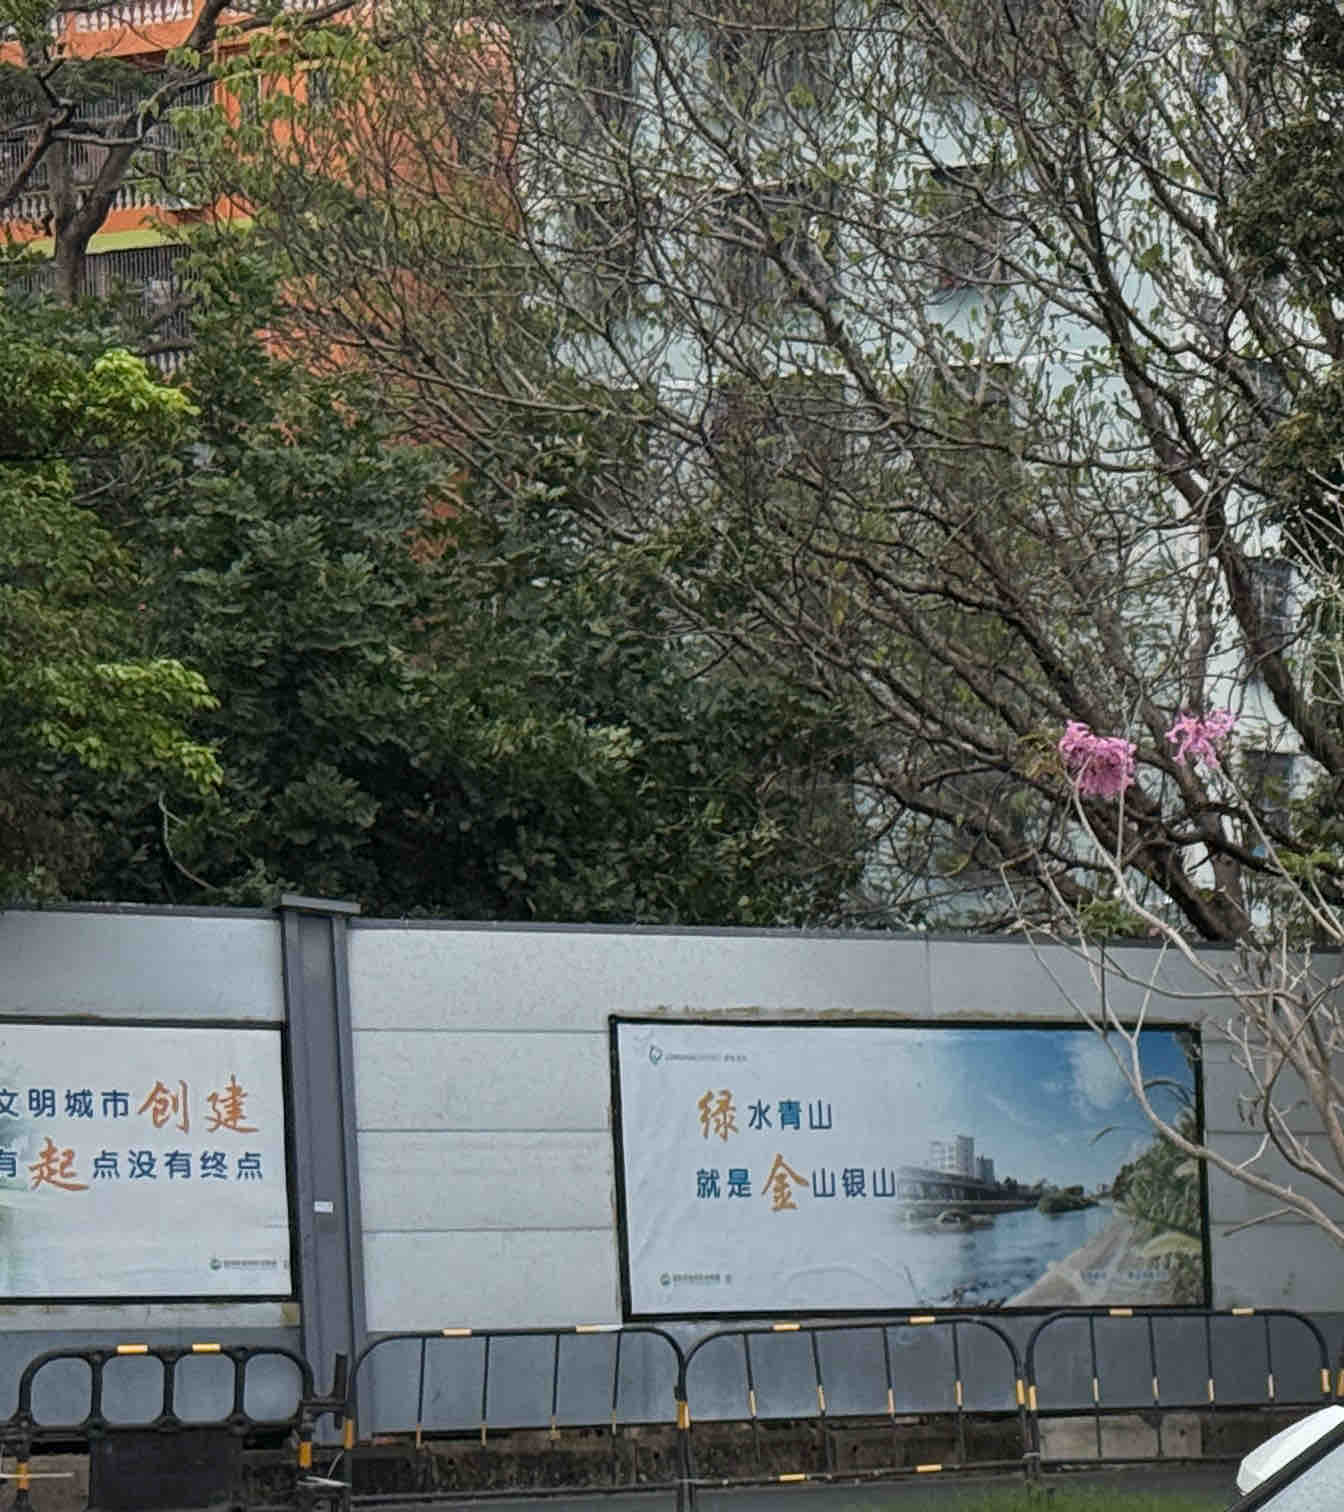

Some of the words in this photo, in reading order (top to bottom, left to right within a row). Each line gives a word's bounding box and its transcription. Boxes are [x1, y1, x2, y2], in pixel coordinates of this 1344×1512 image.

[698, 1088, 833, 1142] 绿水青山
[696, 1152, 897, 1213] 就是金山银山
